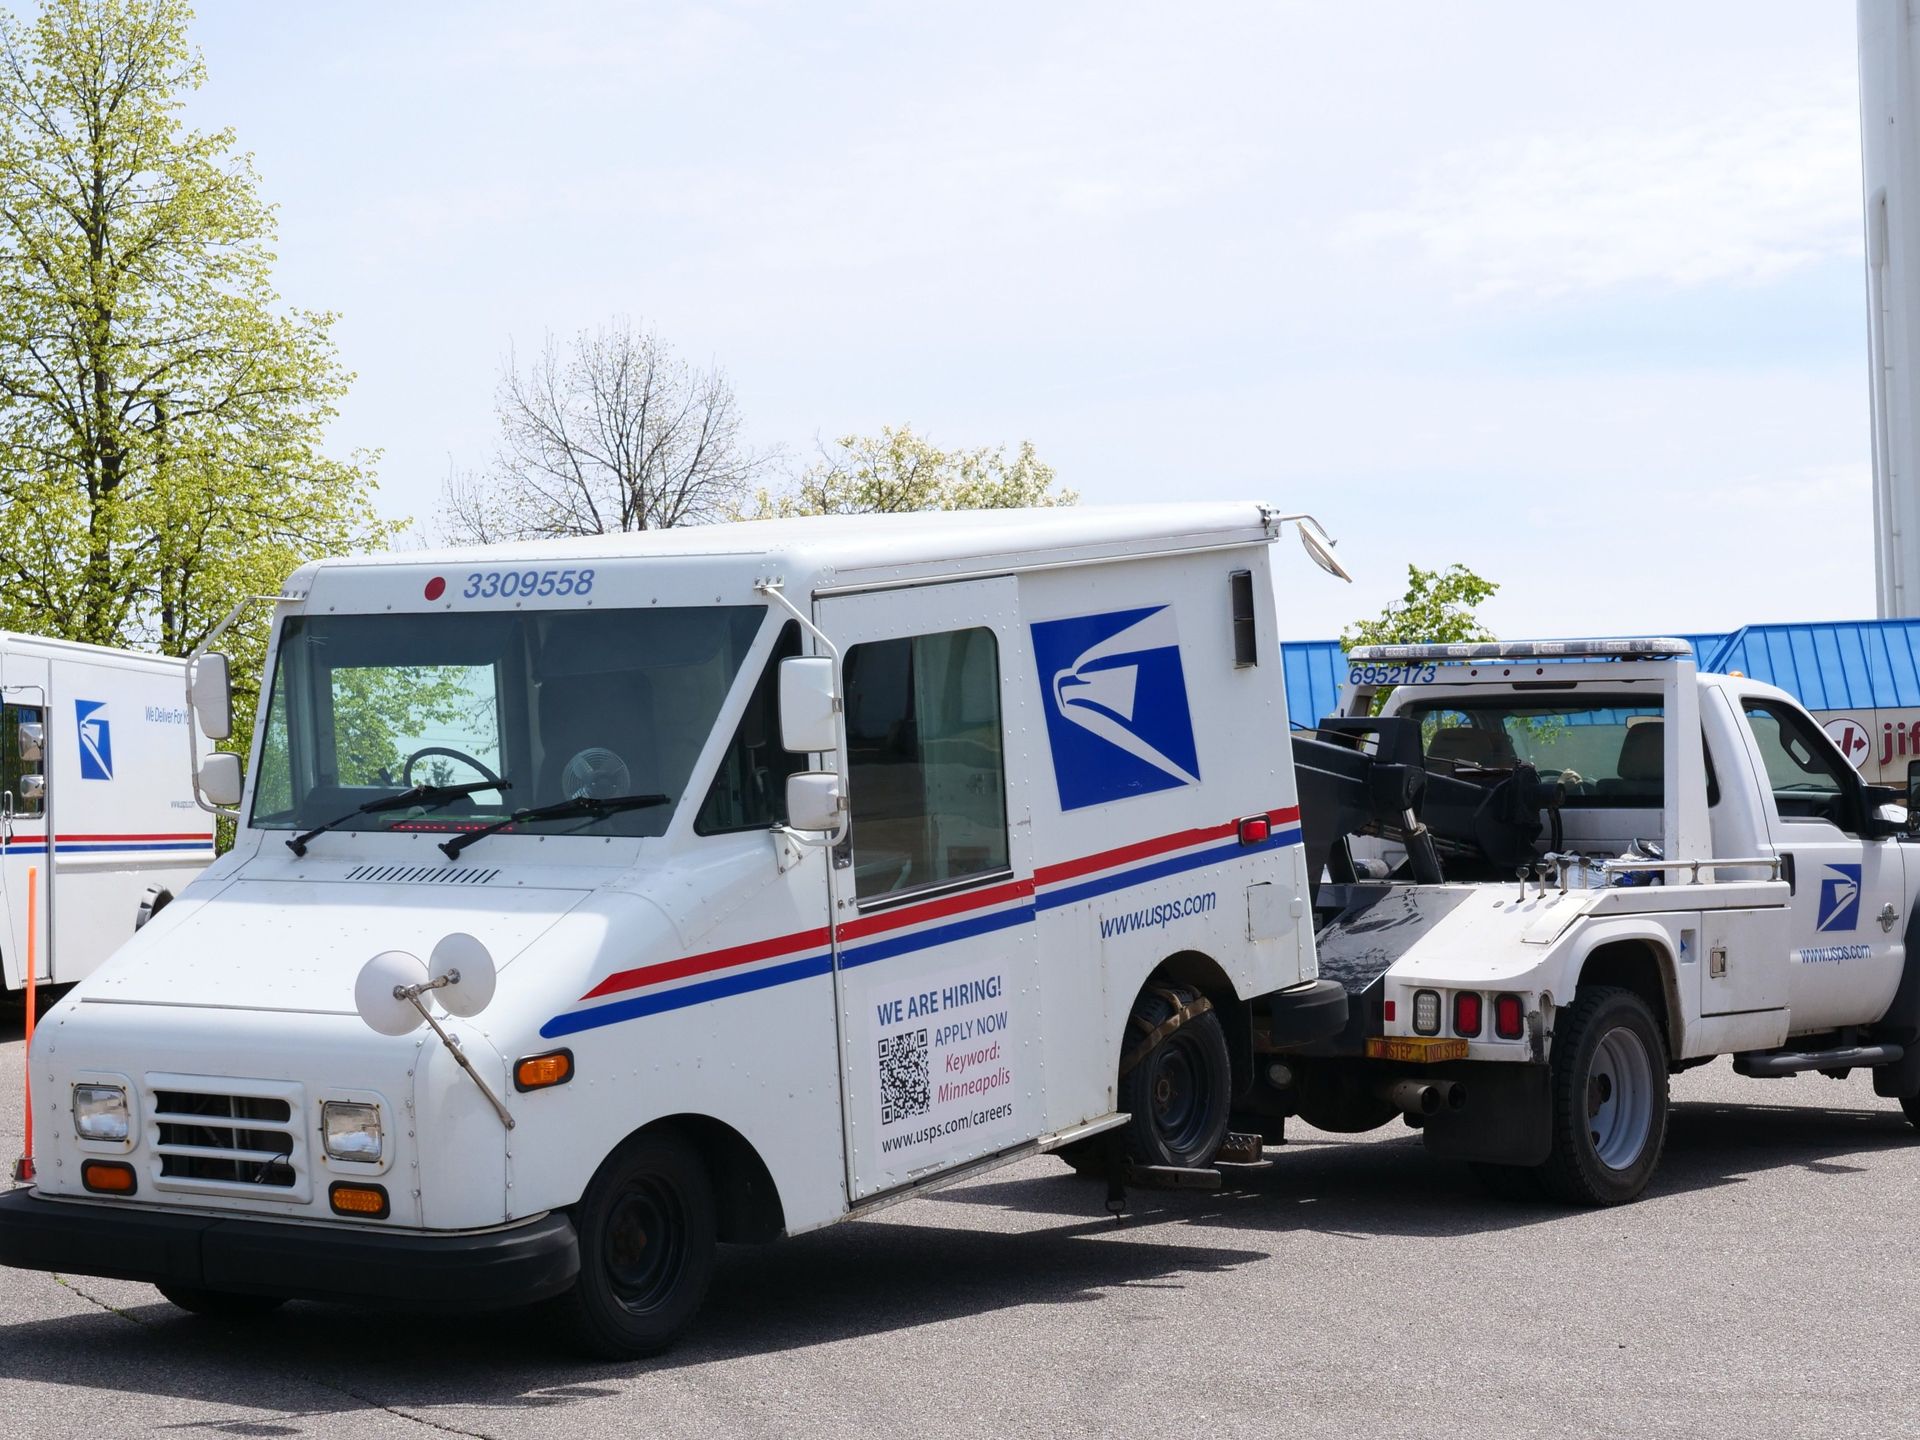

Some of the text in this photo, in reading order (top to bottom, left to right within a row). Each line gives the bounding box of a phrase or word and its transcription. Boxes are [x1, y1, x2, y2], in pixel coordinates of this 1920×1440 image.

[463, 569, 595, 598] 3309558
[1349, 665, 1436, 685] 6952173
[145, 705, 154, 722] We
[155, 706, 173, 723] Deliver
[174, 709, 182, 724] For
[1100, 891, 1216, 939] www.usps.com
[1800, 944, 1871, 965] www.usps.com
[877, 975, 1002, 1026] WE ARE HIRING!
[934, 1010, 1008, 1047] APPLY NOW
[945, 1040, 1001, 1074] Keyword:
[1388, 1044, 1412, 1060] STEP
[1444, 1041, 1466, 1058] STEP
[937, 1066, 1011, 1104] Minneapolis
[882, 1102, 1013, 1153] www.usps.com/careers
